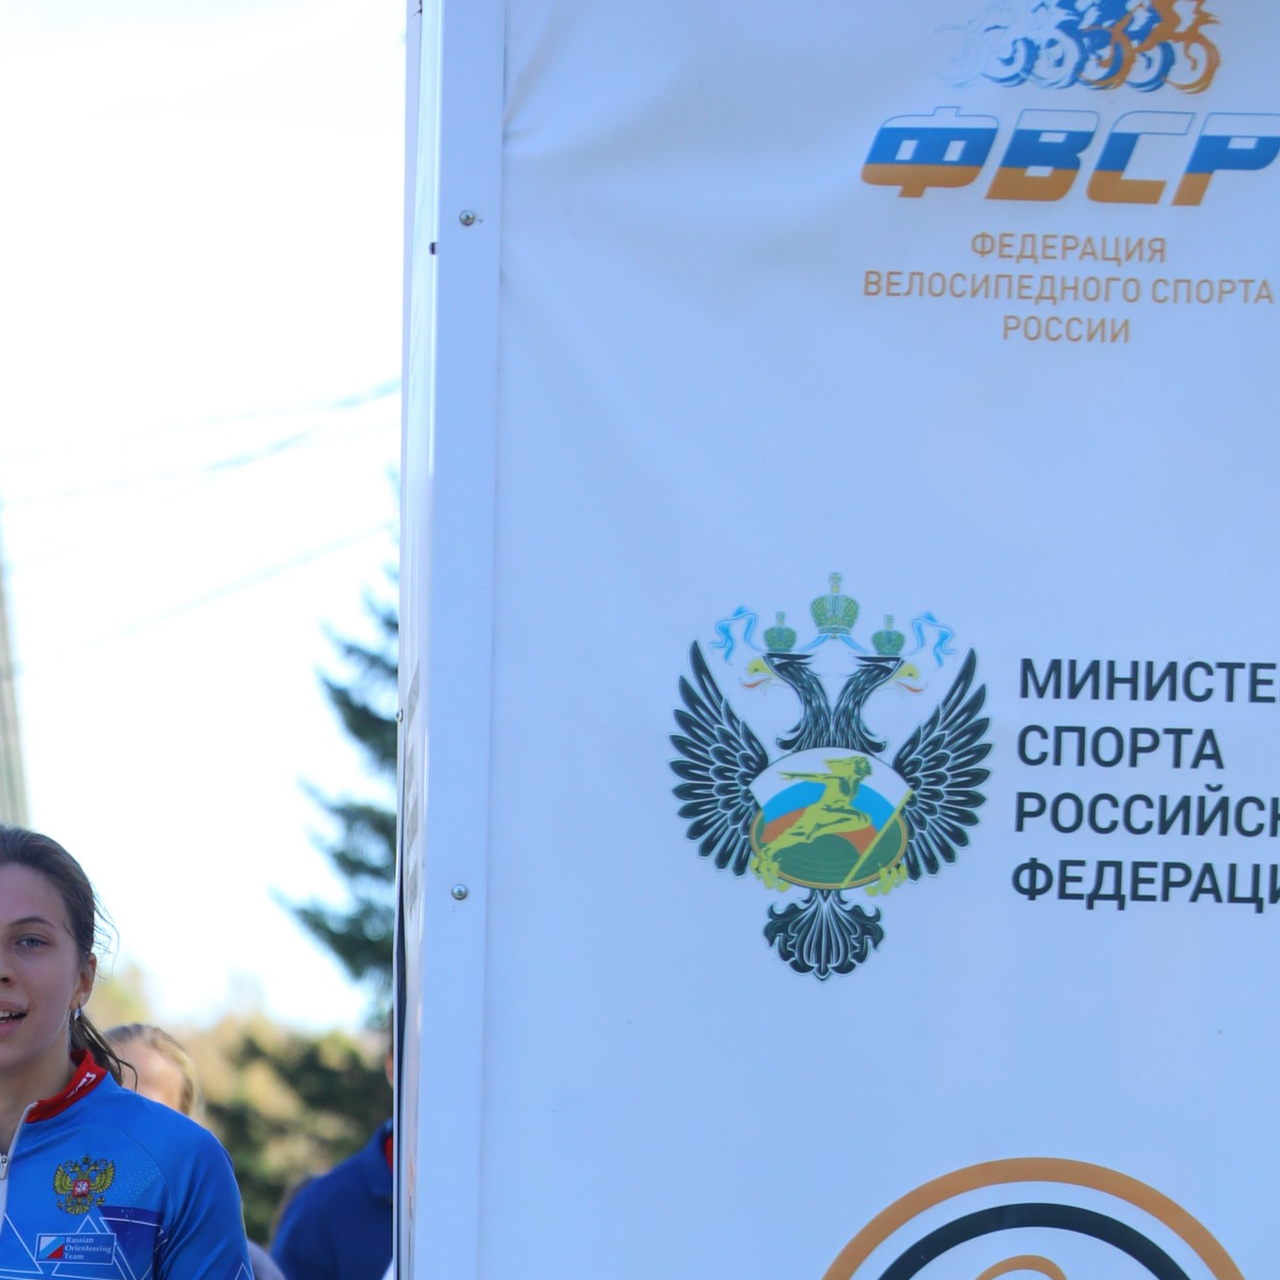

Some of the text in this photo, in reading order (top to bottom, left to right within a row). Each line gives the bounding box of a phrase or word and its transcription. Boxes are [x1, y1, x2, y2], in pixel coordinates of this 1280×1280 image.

[860, 106, 1280, 206] ФВСР
[971, 231, 1167, 267] ФЕДЕРАЦИЯ
[863, 269, 1274, 306] ВЕЛОСИПЕДНОГО СПОРТА
[1002, 315, 1131, 344] РОССИИ
[1017, 724, 1225, 769] СПОРТА
[63, 1252, 85, 1260] Team
[64, 1244, 112, 1255] Orienteering
[65, 1236, 95, 1244] Russian
